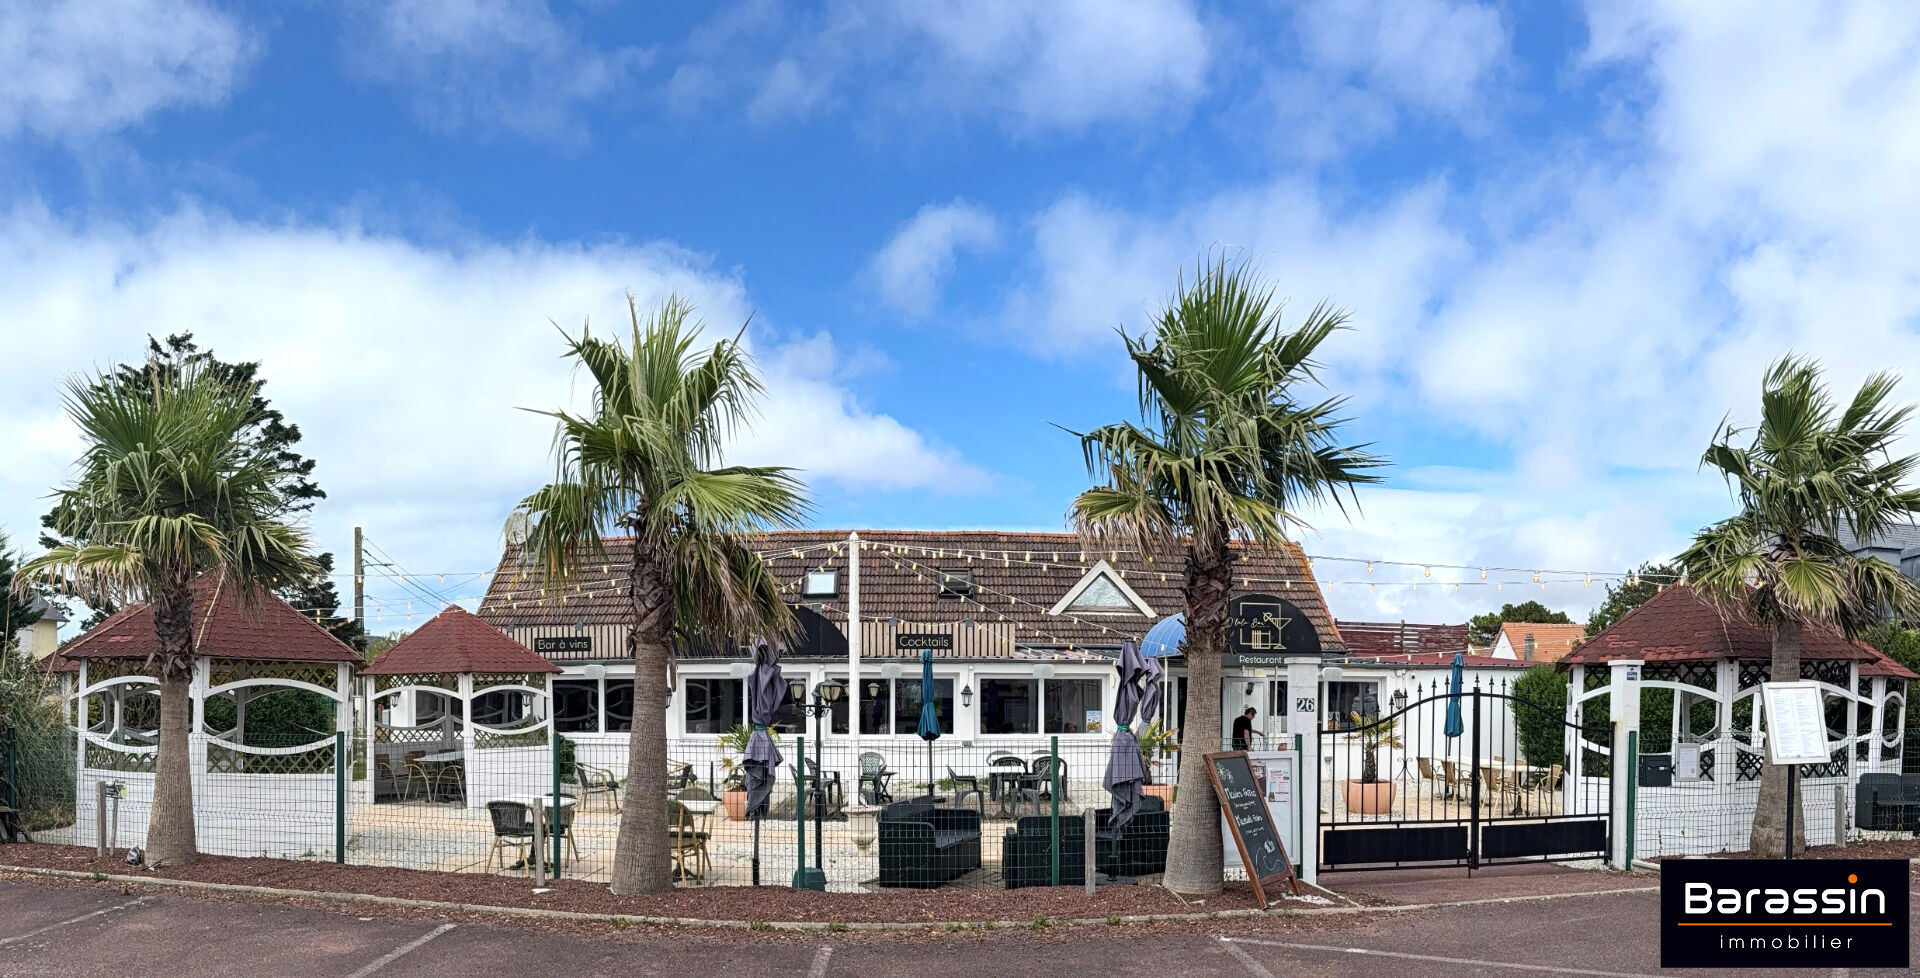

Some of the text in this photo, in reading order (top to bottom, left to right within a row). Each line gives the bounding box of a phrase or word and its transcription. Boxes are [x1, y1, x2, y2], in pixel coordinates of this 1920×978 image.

[538, 639, 588, 650] Bar à vins
[900, 635, 949, 647] Cocktails
[1239, 655, 1282, 664] Restaurant
[1297, 698, 1314, 712] 26
